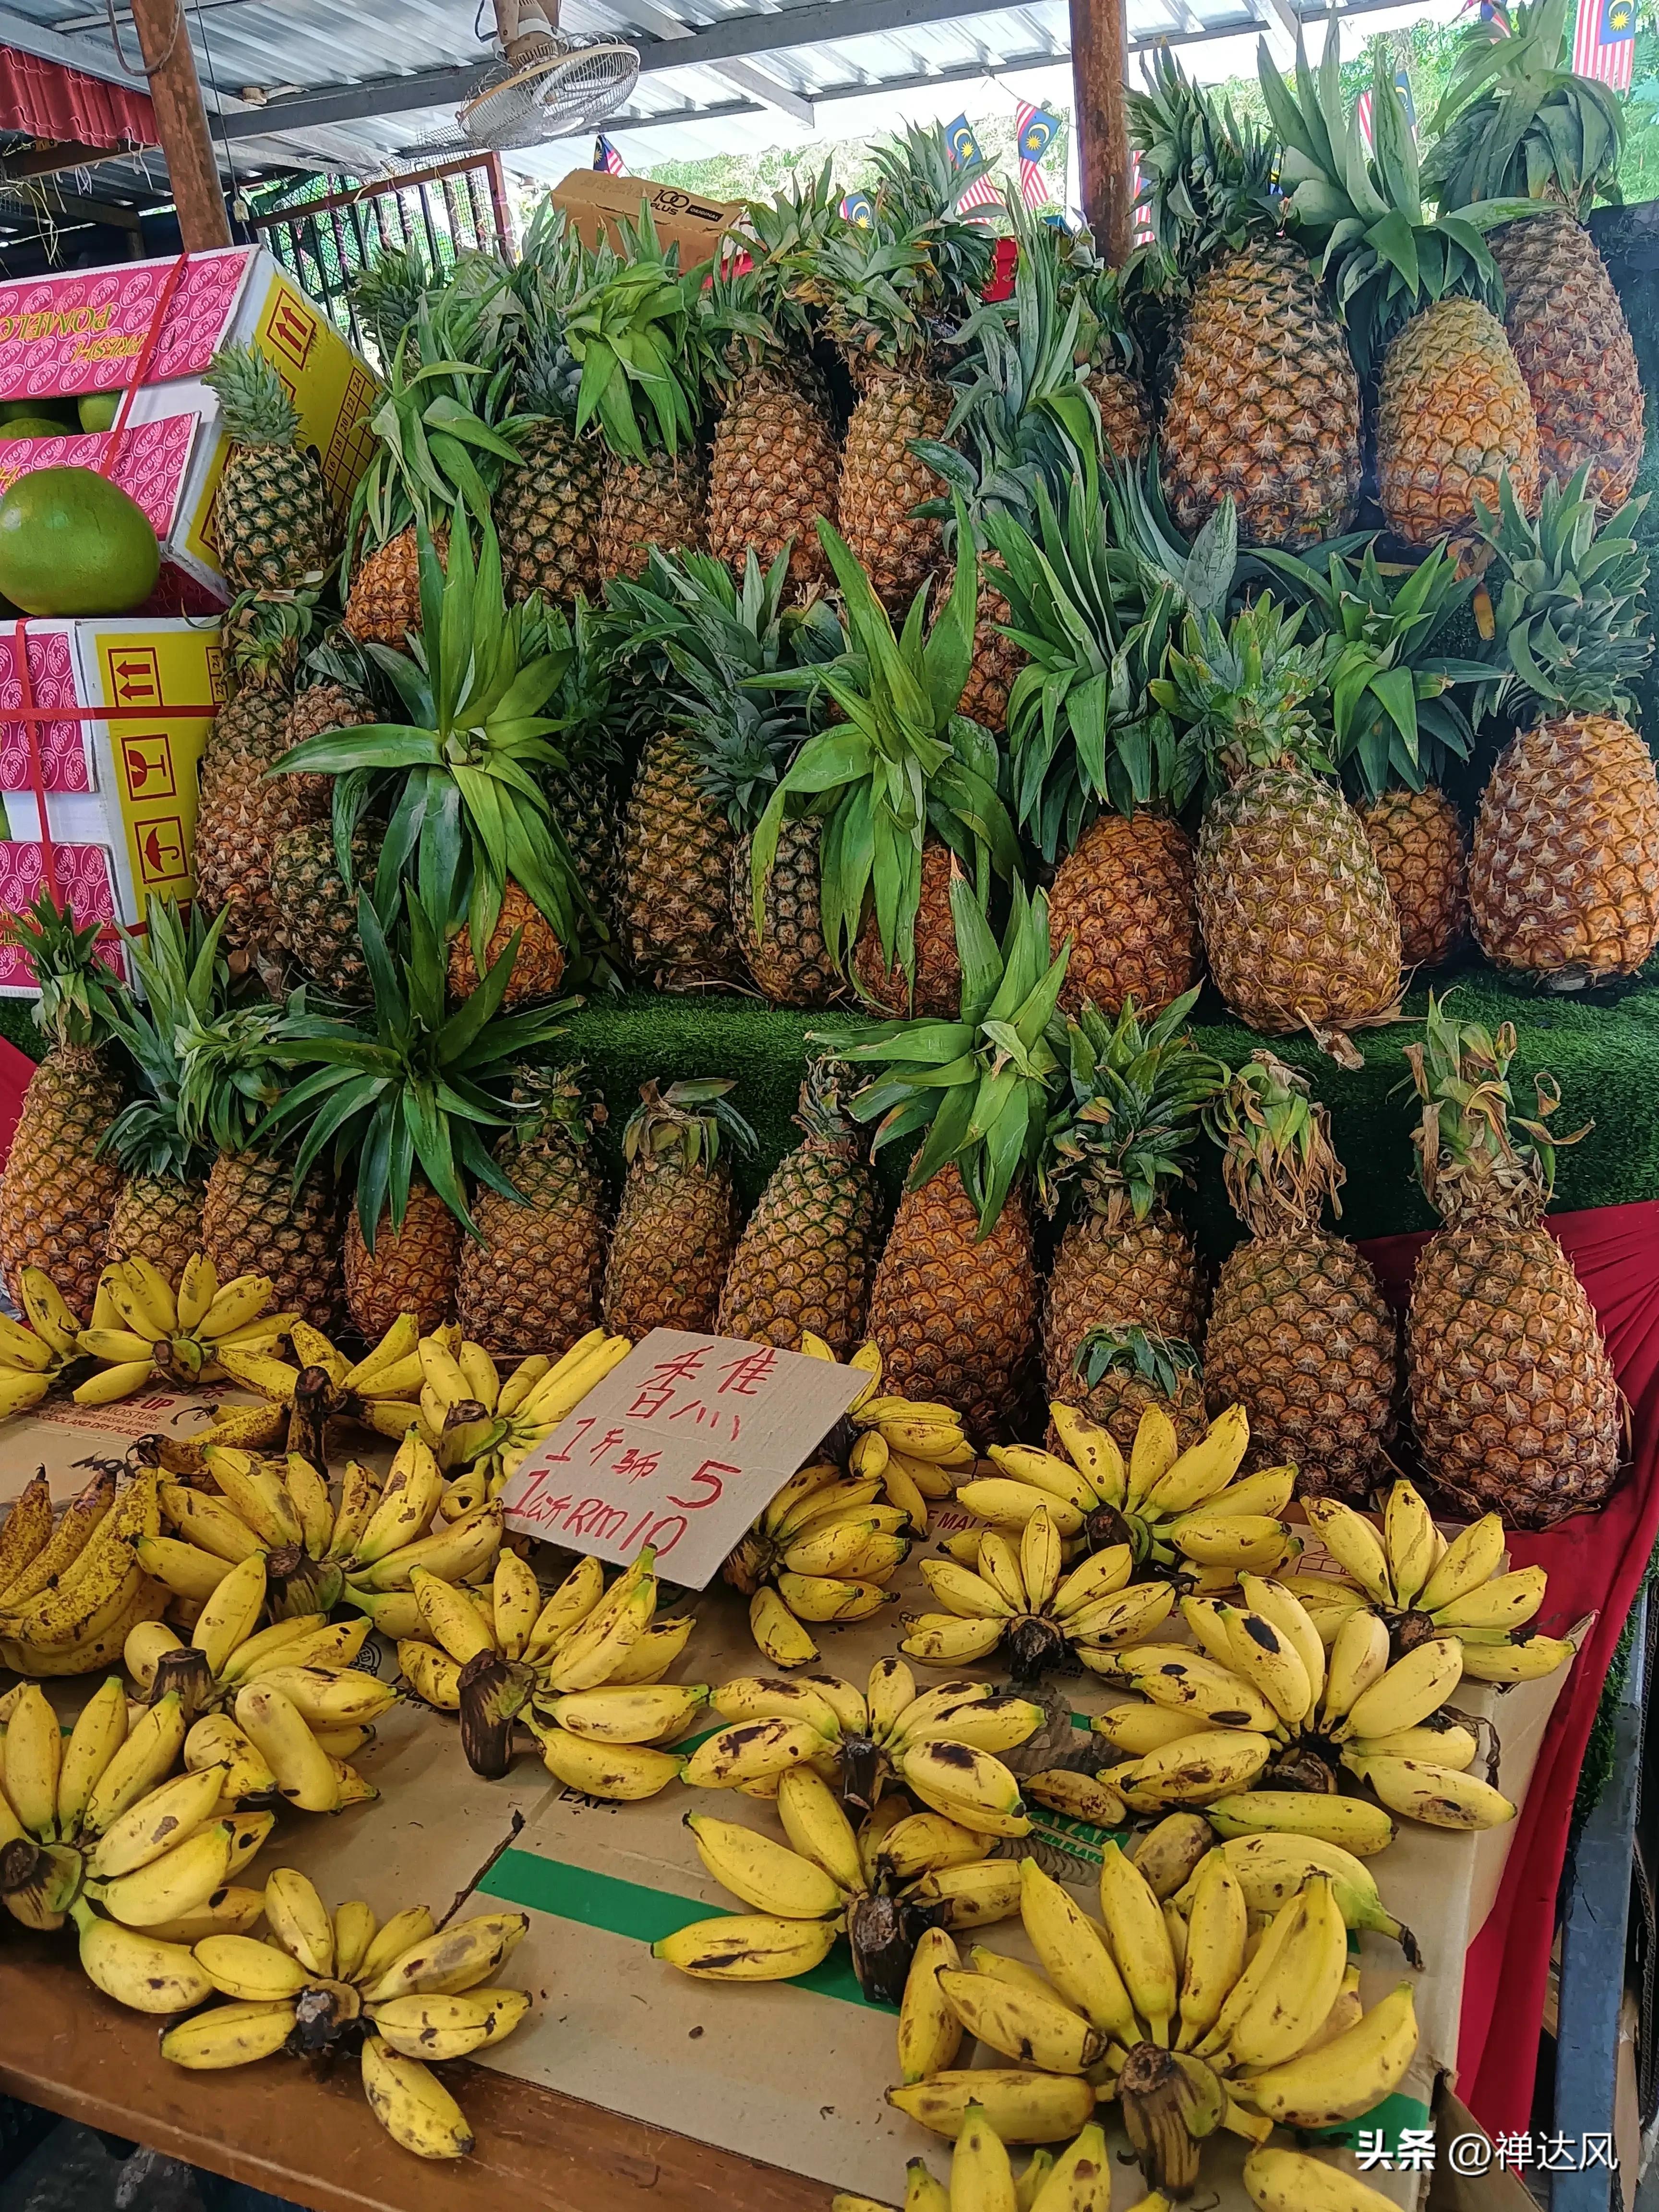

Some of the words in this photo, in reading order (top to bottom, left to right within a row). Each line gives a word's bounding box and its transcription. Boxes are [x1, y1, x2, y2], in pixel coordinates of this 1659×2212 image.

[653, 189, 690, 208] 100
[650, 203, 679, 216] PLUS
[690, 207, 719, 220] ORIGINAL
[71, 333, 148, 363] FRESH
[352, 375, 362, 392] 24
[346, 397, 356, 412] 22
[340, 418, 349, 433] 20
[333, 438, 343, 453] 18
[327, 458, 336, 474] 16
[211, 654, 220, 669] 24
[215, 682, 225, 696] 22
[140, 1396, 176, 1411] UP
[107, 1407, 165, 1423] MOISTURE
[42, 1414, 68, 1424] COOL
[90, 1422, 113, 1430] DRY
[110, 1425, 146, 1437] PLACE
[666, 1460, 742, 1509] 5
[1062, 1841, 1104, 1865] FLAVO
